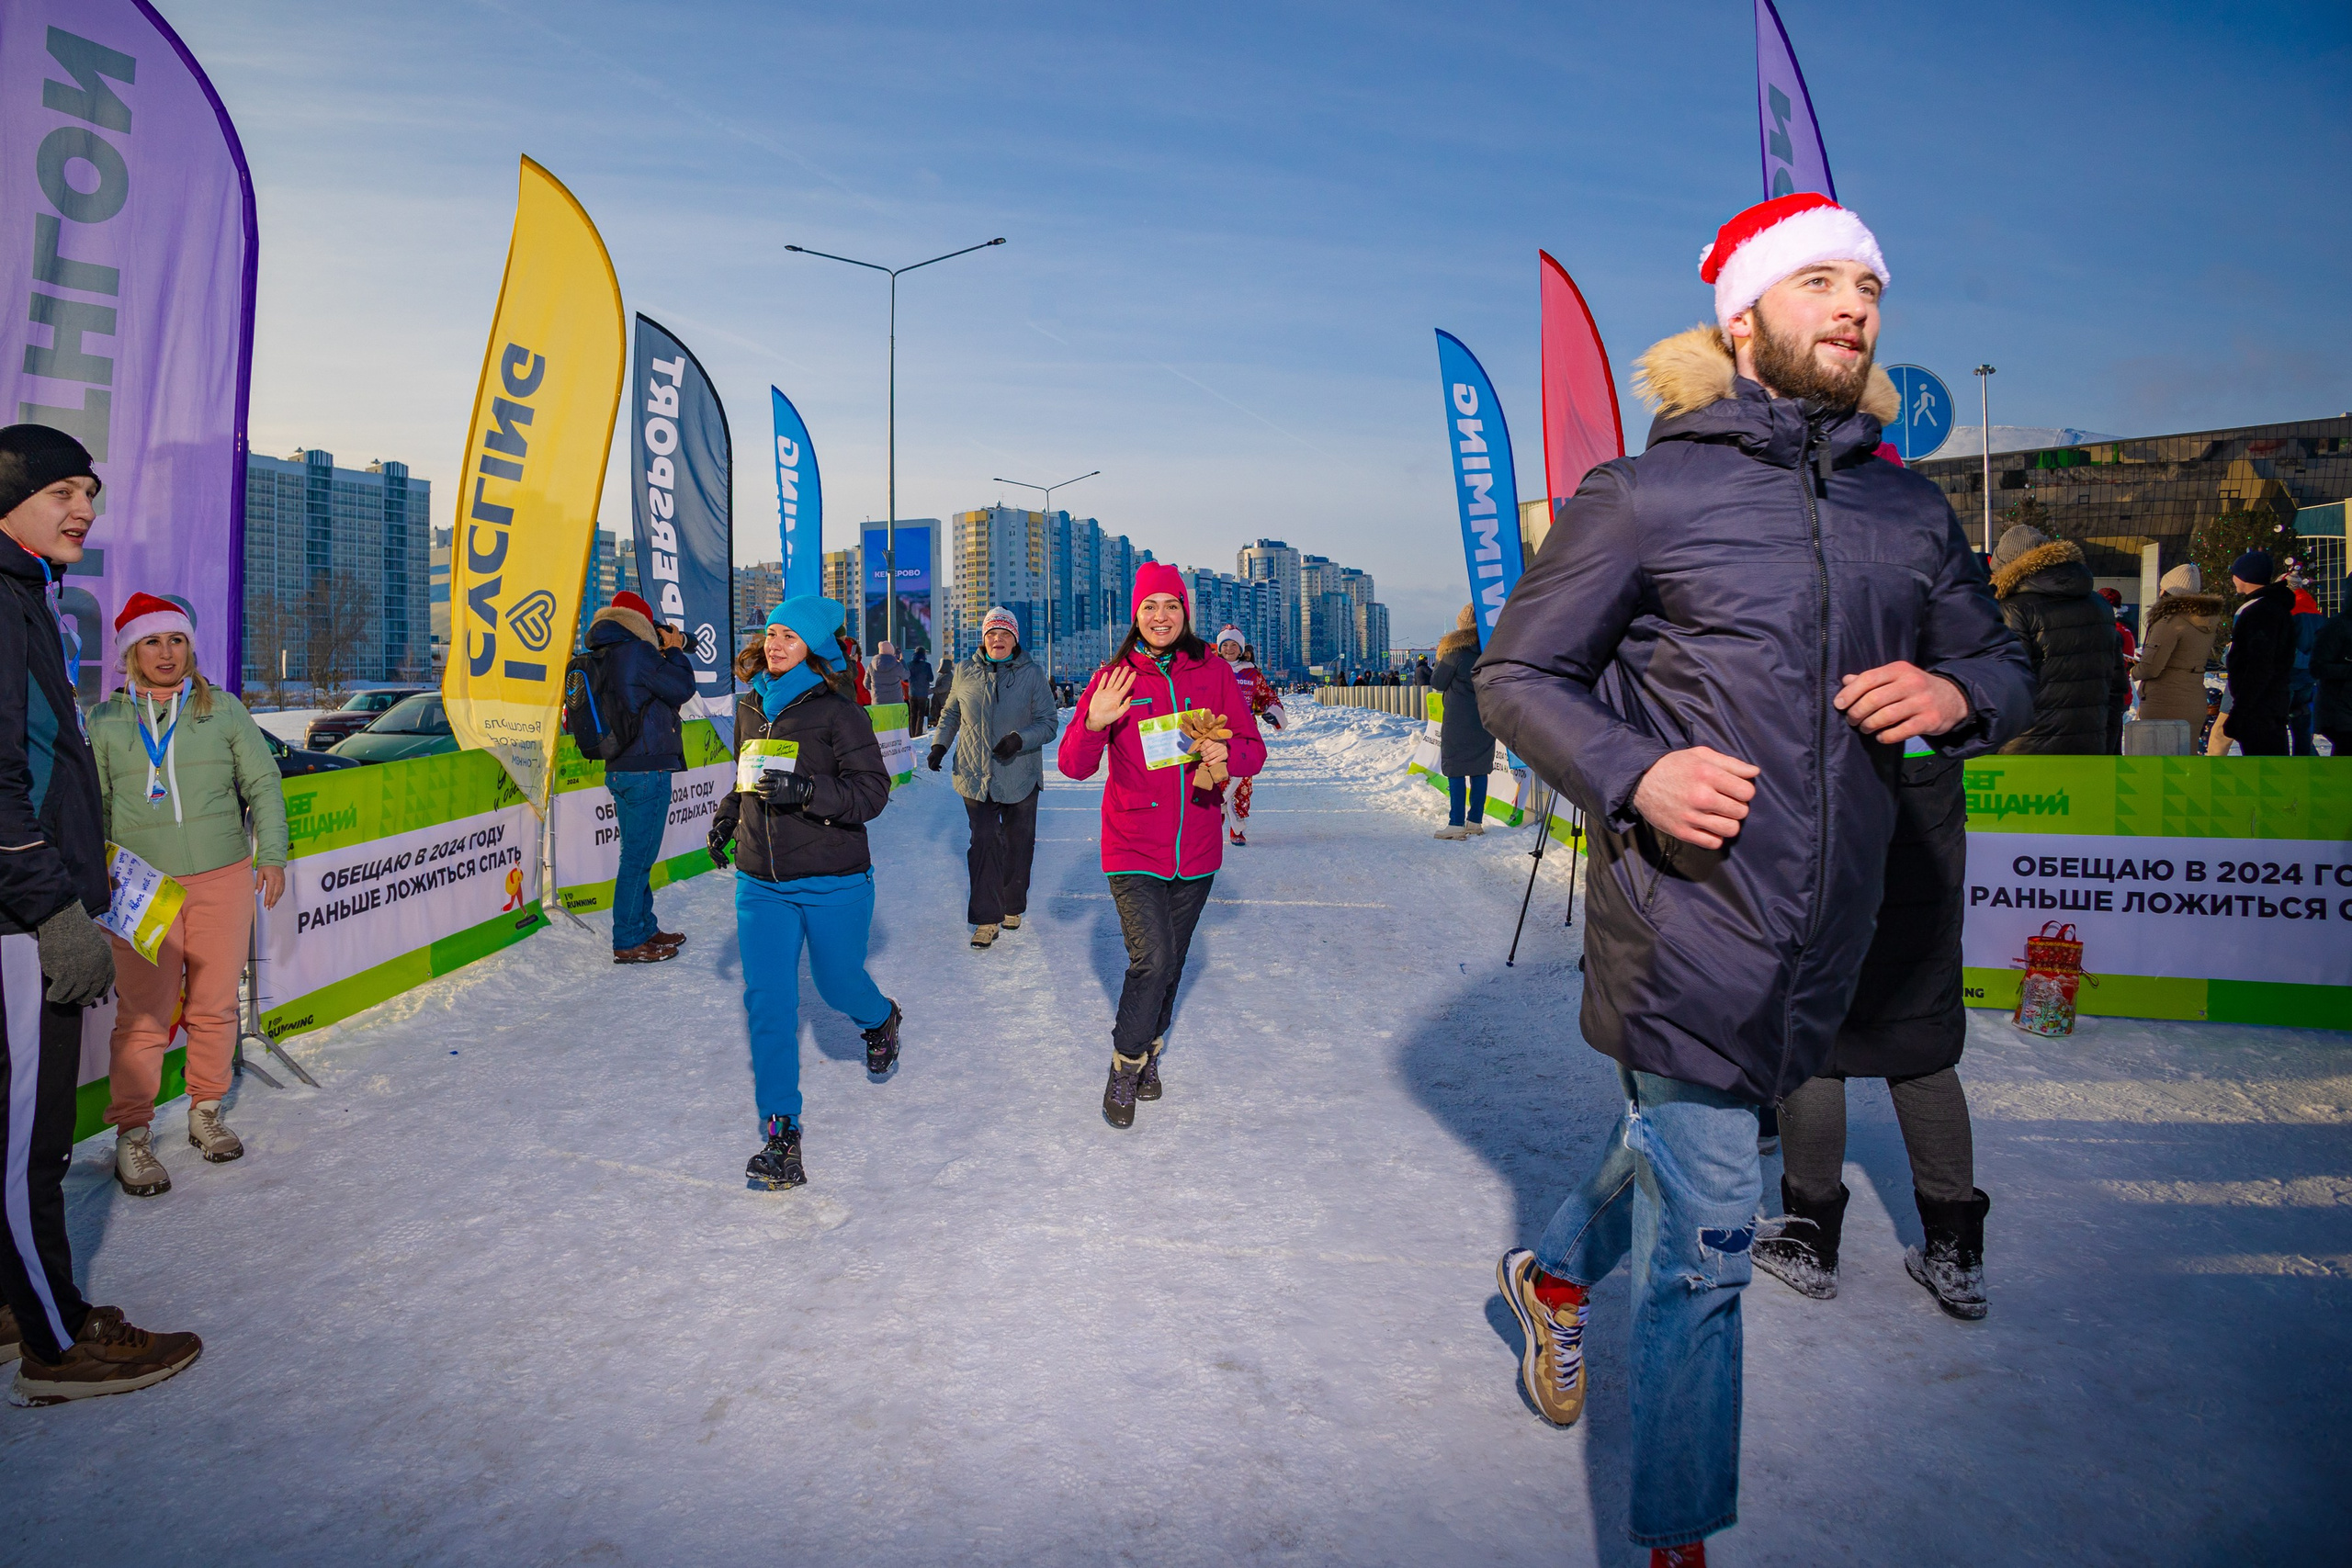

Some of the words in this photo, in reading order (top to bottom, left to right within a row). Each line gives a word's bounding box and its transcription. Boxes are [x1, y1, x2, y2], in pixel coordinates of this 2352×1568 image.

[670, 786, 688, 805] 024
[691, 780, 715, 799] ГОДУ
[1966, 786, 2069, 822] ЕЩАНИЙ
[288, 801, 357, 843] ЕЩАНИЙ
[669, 800, 718, 826] ОТДЫХАТЬ
[321, 852, 412, 892] ОБЕЩАЮ
[414, 847, 428, 866] В
[429, 836, 466, 861] 2024
[469, 825, 505, 850] ГОДУ
[2012, 855, 2174, 883] ОБЕЩАЮ
[2185, 861, 2207, 882] В
[2216, 861, 2303, 886] 2024
[2314, 864, 2352, 887] ГО
[298, 888, 380, 934] РАНЬШЕ
[385, 858, 476, 905] ЛОЖИТЬСЯ
[479, 845, 521, 873] СПАТЬ
[566, 897, 597, 908] RUNNING
[1970, 886, 2113, 912] РАНЬШЕ
[2122, 892, 2327, 920] ЛОЖИТЬСЯ
